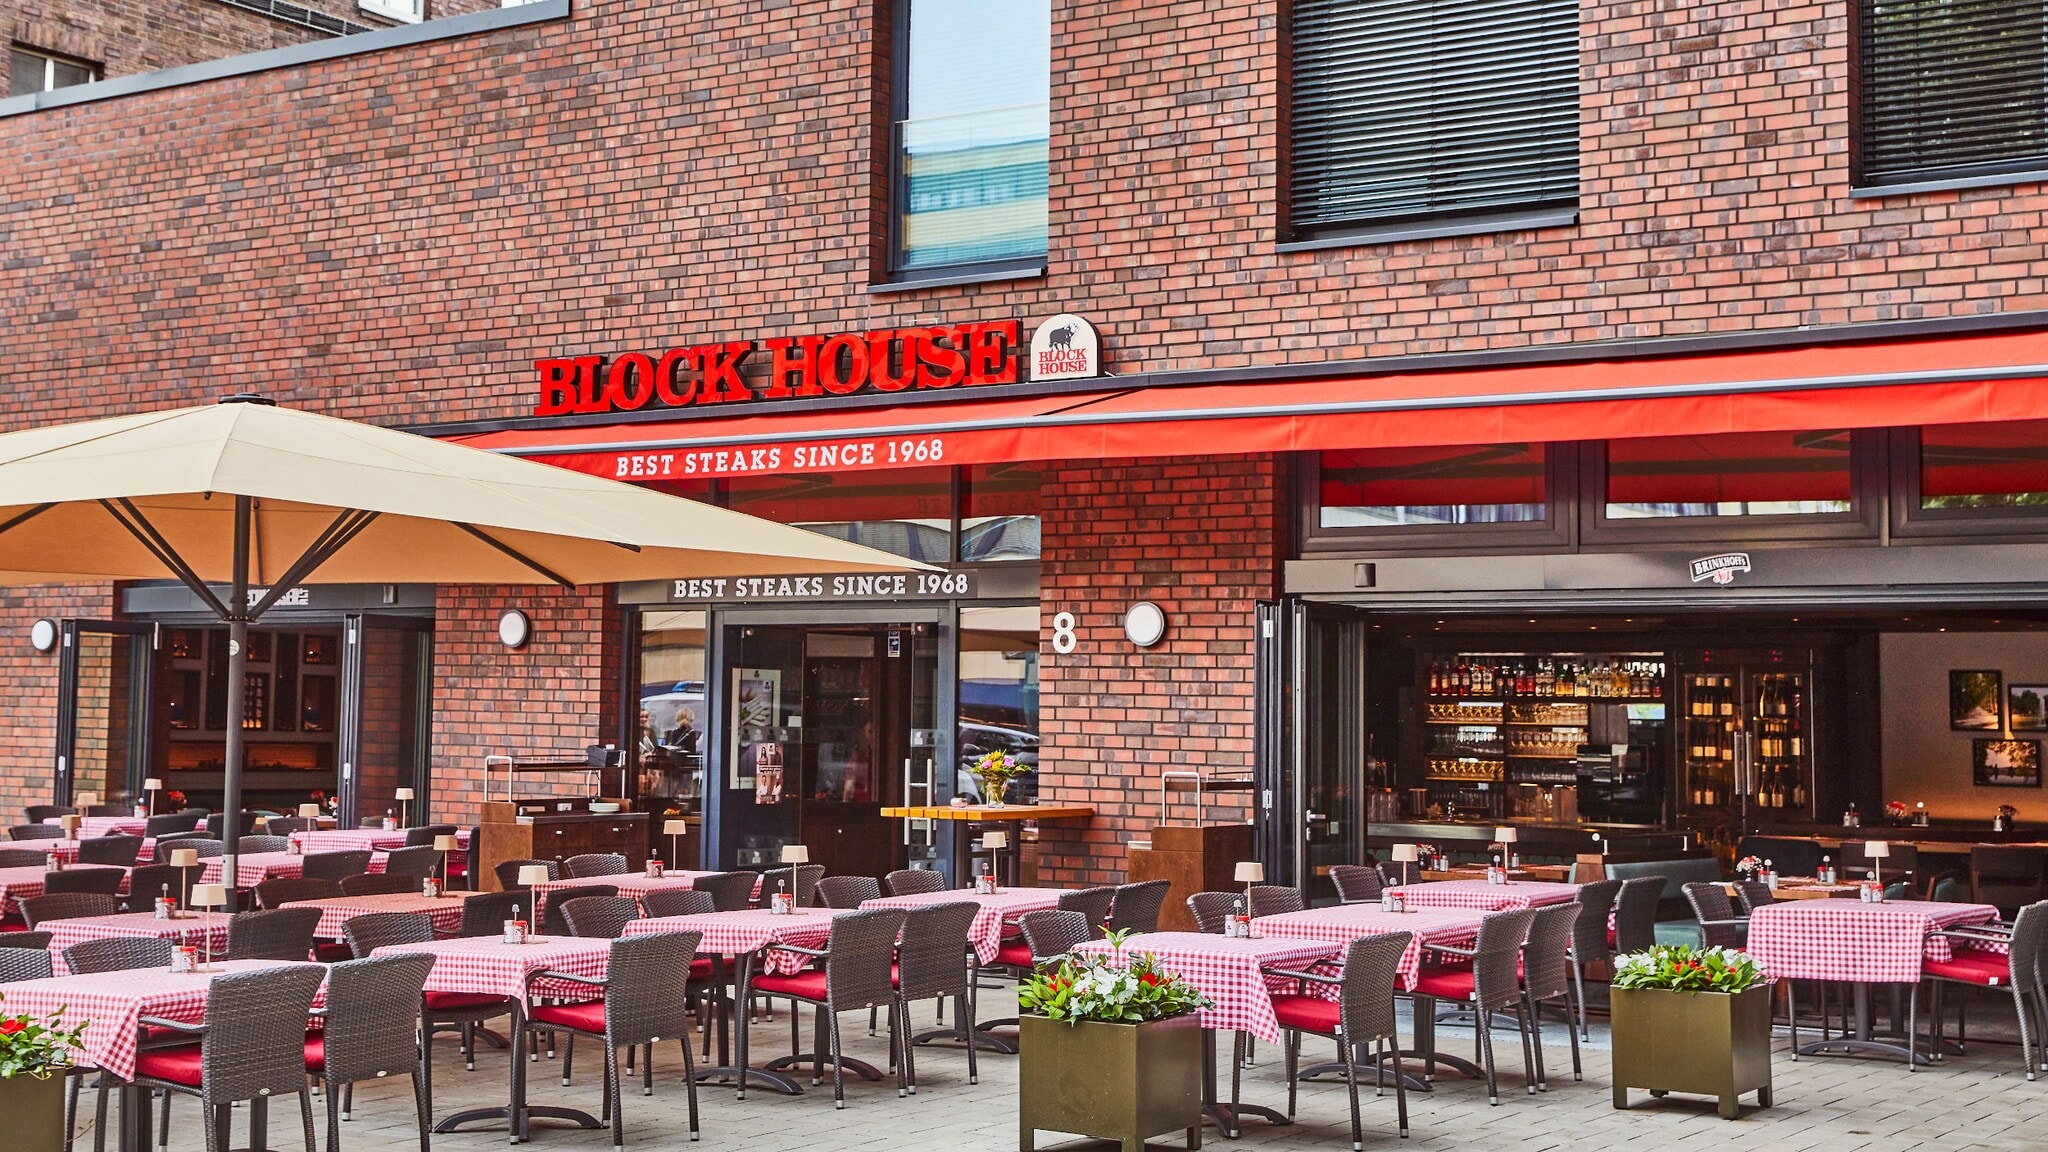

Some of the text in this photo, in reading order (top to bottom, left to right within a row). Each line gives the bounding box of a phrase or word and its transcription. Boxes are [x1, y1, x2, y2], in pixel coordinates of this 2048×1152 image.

[534, 320, 1017, 416] BLOCK HOUSE
[1039, 348, 1087, 363] BLOCK
[1039, 360, 1087, 375] HOUSE
[616, 438, 943, 477] BEST STEAKS SINCE 1968
[674, 573, 968, 598] BEST STEAKS SINCE 1968
[1053, 612, 1076, 654] 8
